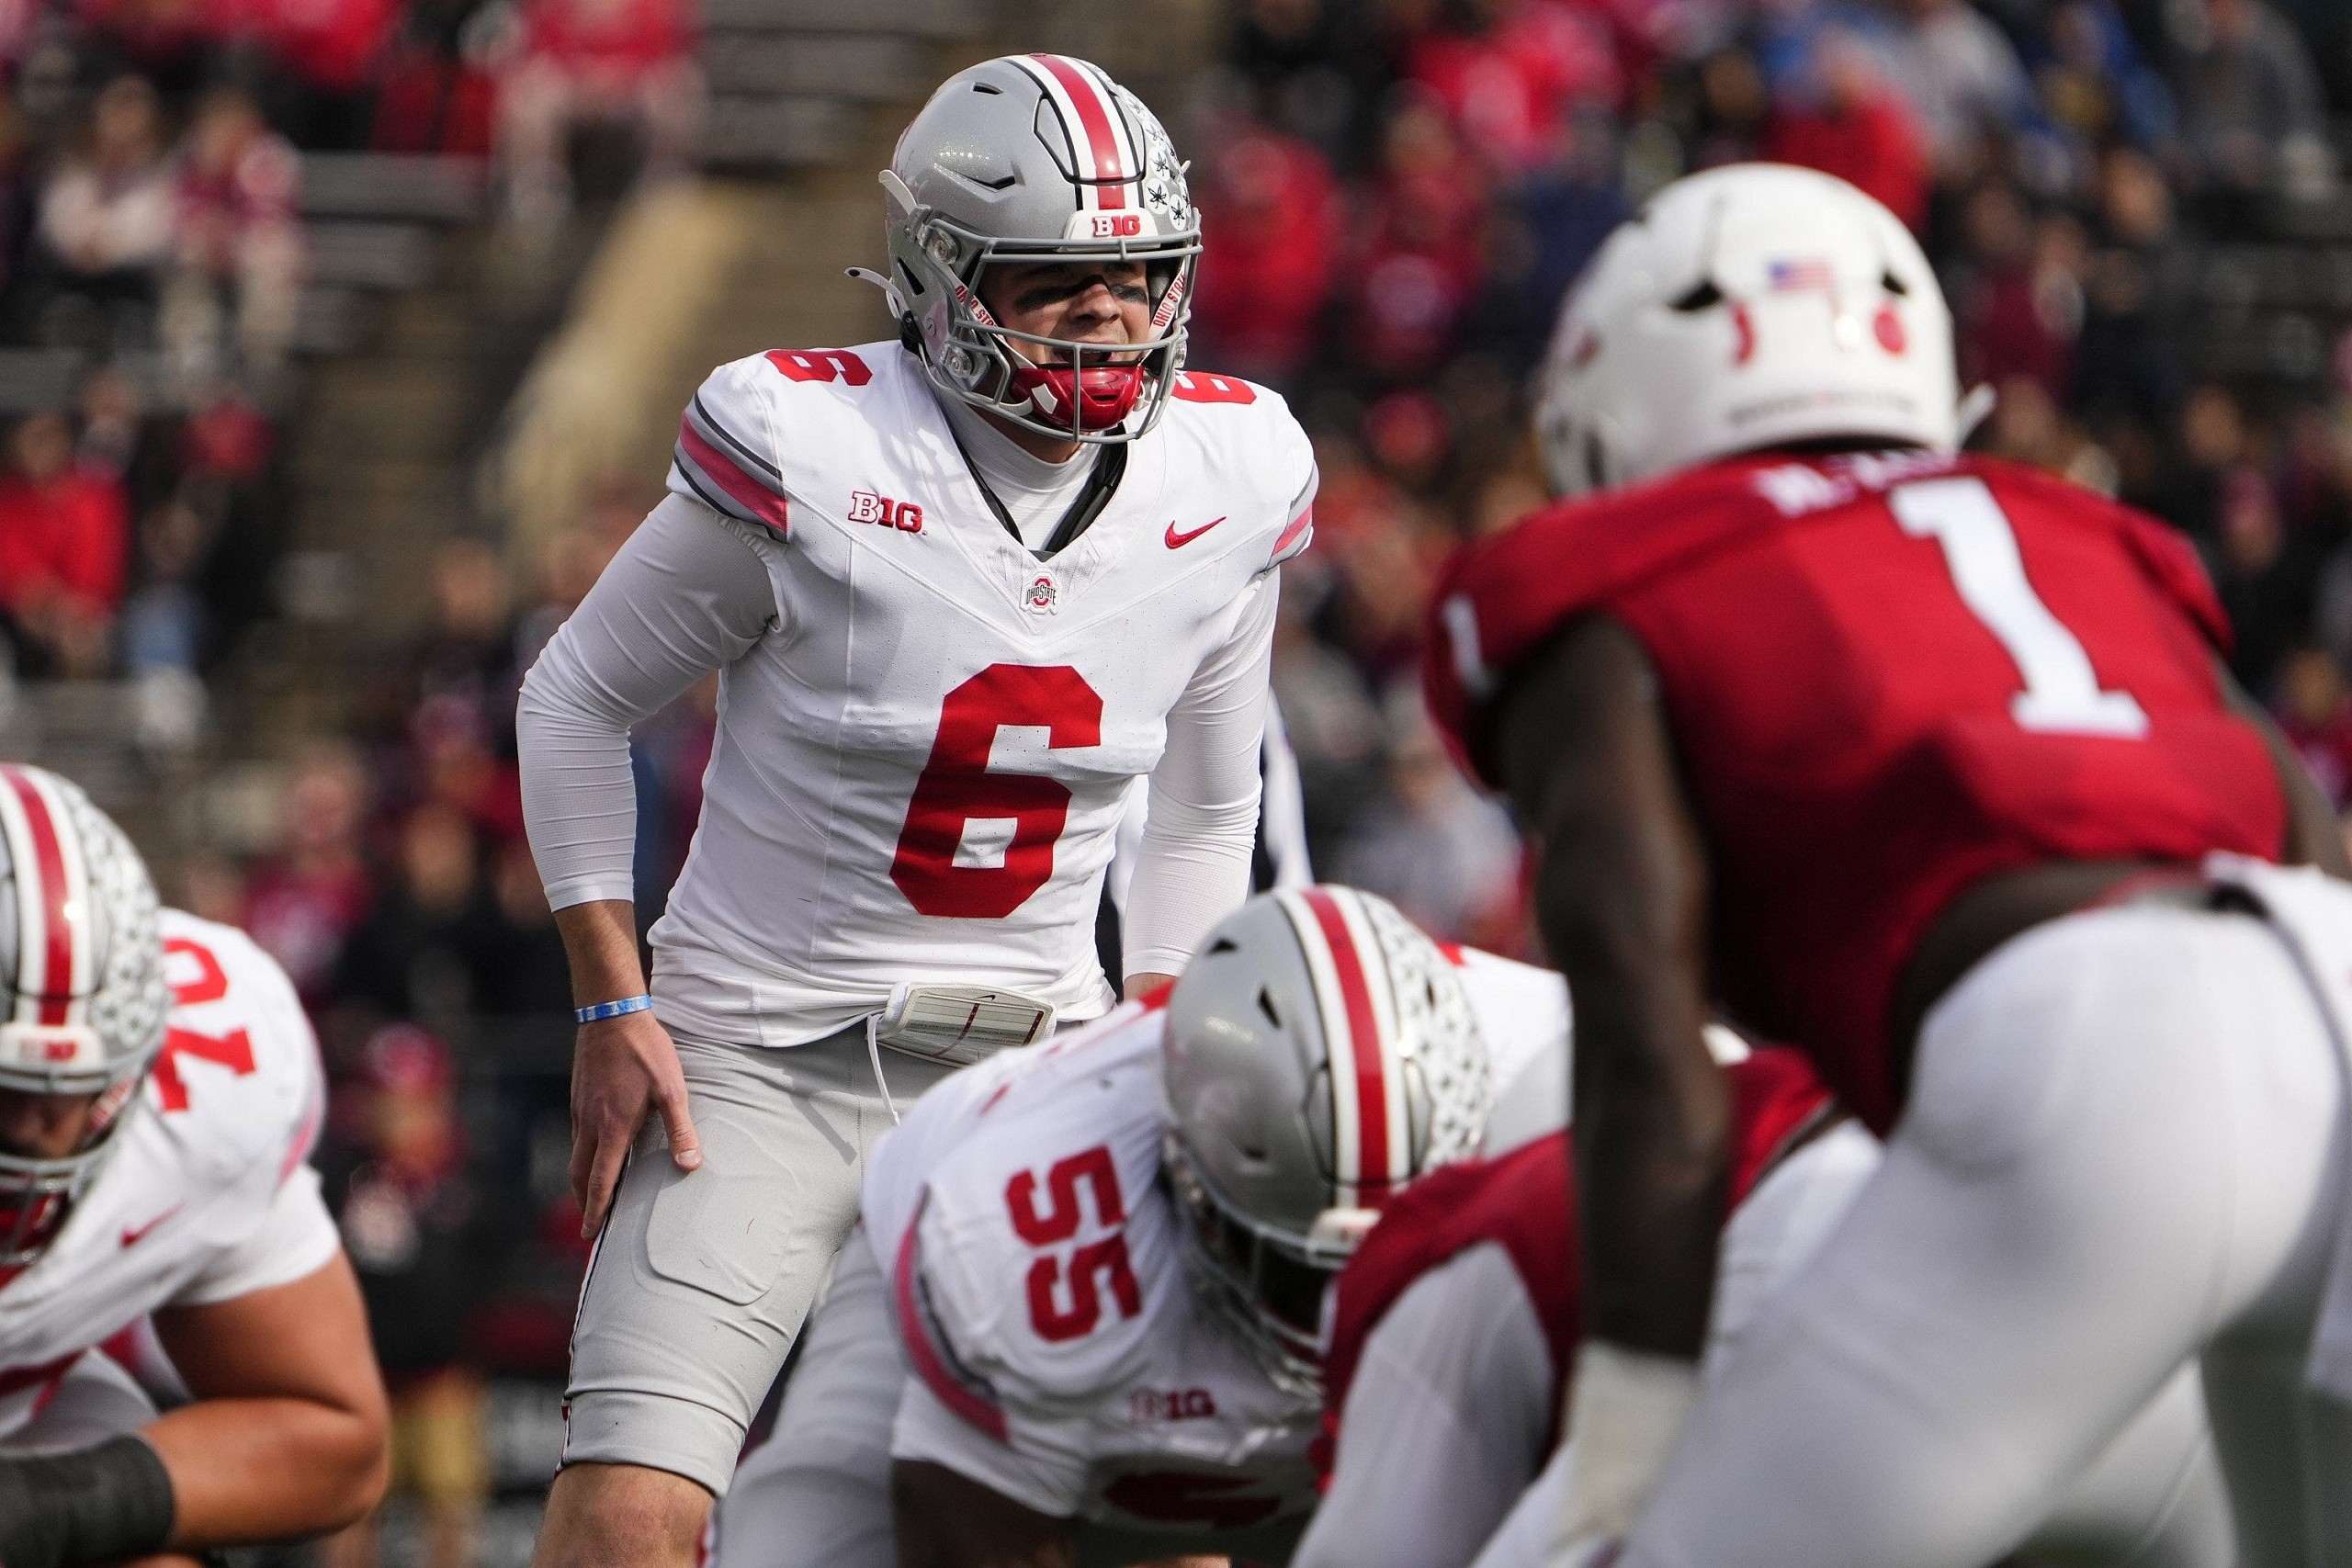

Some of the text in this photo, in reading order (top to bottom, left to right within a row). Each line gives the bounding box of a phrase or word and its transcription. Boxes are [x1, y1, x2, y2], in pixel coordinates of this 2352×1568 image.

[764, 350, 873, 386] 6
[1153, 302, 1174, 327] OHIO
[1890, 476, 2151, 739] 1
[889, 663, 1103, 919] 6
[1005, 1145, 1141, 1341] 55
